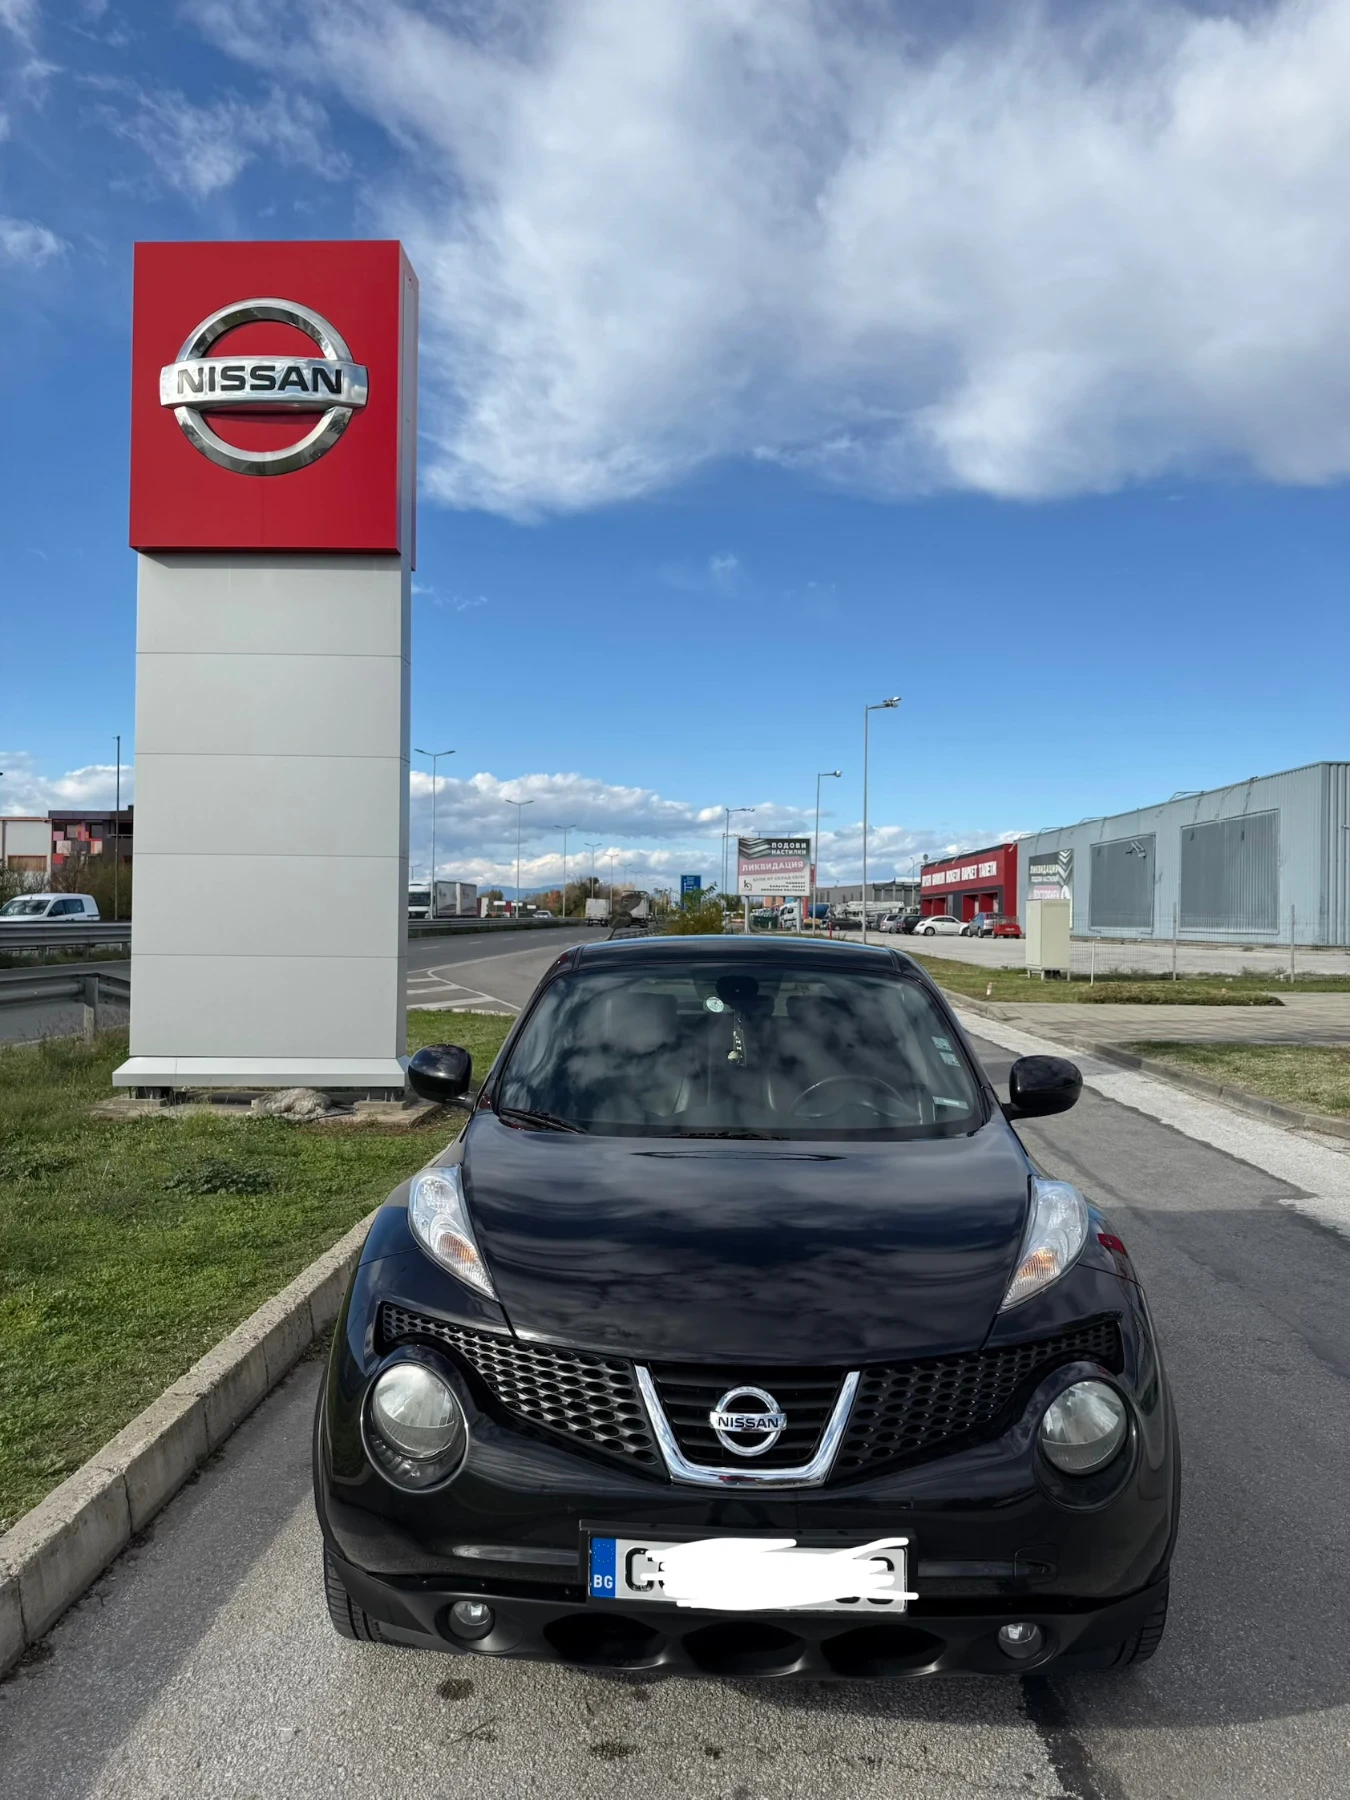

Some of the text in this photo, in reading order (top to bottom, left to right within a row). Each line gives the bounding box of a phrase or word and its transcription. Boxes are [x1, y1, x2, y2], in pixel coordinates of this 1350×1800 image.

[177, 365, 342, 395] NISSAN
[742, 861, 804, 872] ЛИКВИДАЦИЯ
[718, 1416, 779, 1428] NISSAN
[593, 1574, 613, 1589] BG
